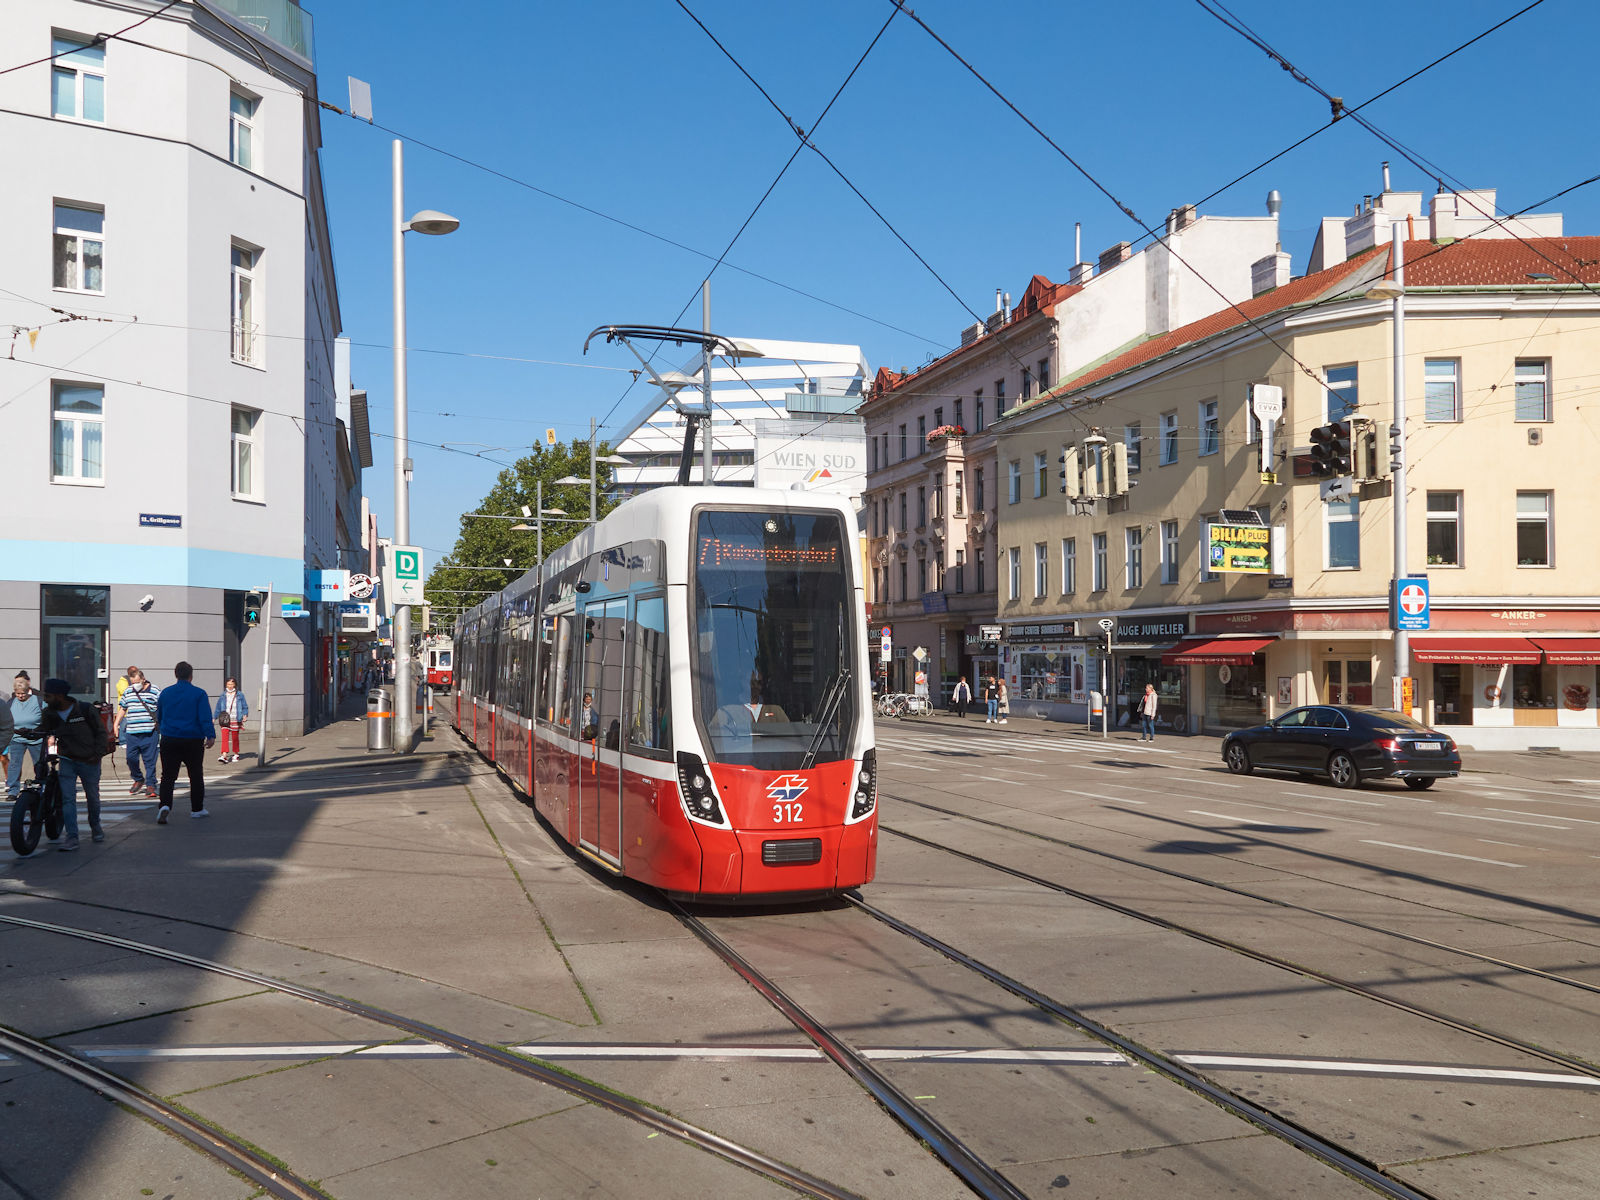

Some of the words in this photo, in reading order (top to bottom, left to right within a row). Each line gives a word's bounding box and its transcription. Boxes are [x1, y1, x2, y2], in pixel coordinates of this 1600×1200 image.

[1258, 403, 1278, 411] EVVA
[774, 452, 816, 467] WIEN
[823, 453, 856, 469] SÜD
[1211, 527, 1246, 542] BILLA
[1247, 532, 1268, 540] PLUS
[700, 538, 720, 565] 71
[722, 543, 837, 563] Kaiserebersdorf
[400, 554, 415, 572] D
[642, 555, 652, 573] 312
[1231, 614, 1253, 622] ANKER
[1499, 611, 1538, 620] ANKER
[1117, 624, 1140, 636] AUGE
[1140, 623, 1185, 636] JUWELIER
[772, 803, 804, 823] 312
